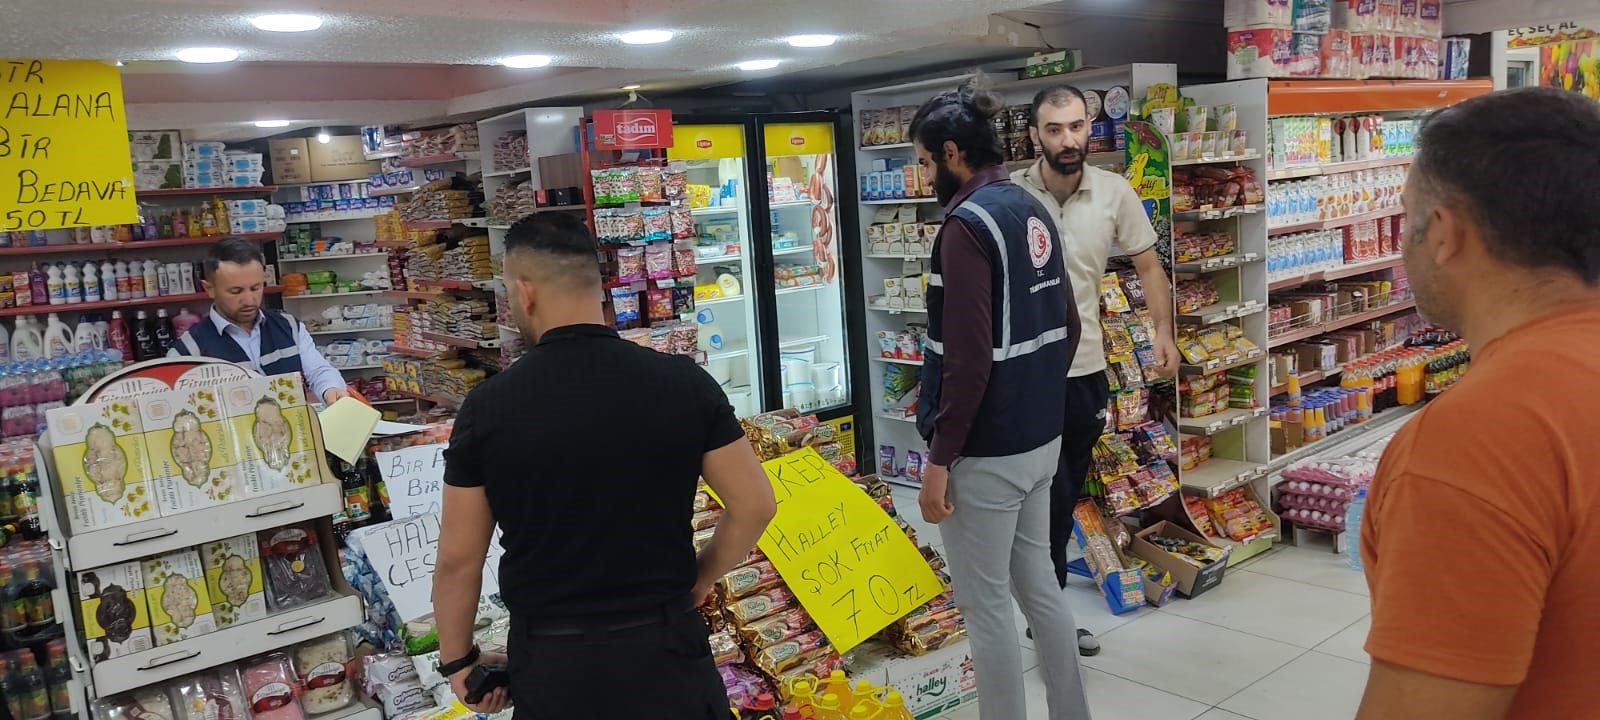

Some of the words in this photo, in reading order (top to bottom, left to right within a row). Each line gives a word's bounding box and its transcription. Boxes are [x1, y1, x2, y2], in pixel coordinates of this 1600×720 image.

[1559, 21, 1578, 30] AL
[0, 60, 44, 83] İR
[6, 92, 115, 122] ALANA
[616, 123, 656, 134] tadım
[17, 169, 126, 204] BEDAVA
[3, 209, 46, 230] 50
[56, 207, 90, 226] TL
[768, 454, 841, 499] KER
[765, 502, 847, 562] HALLEY
[832, 574, 900, 640] 70
[903, 584, 925, 606] TL
[916, 676, 947, 696] halley
